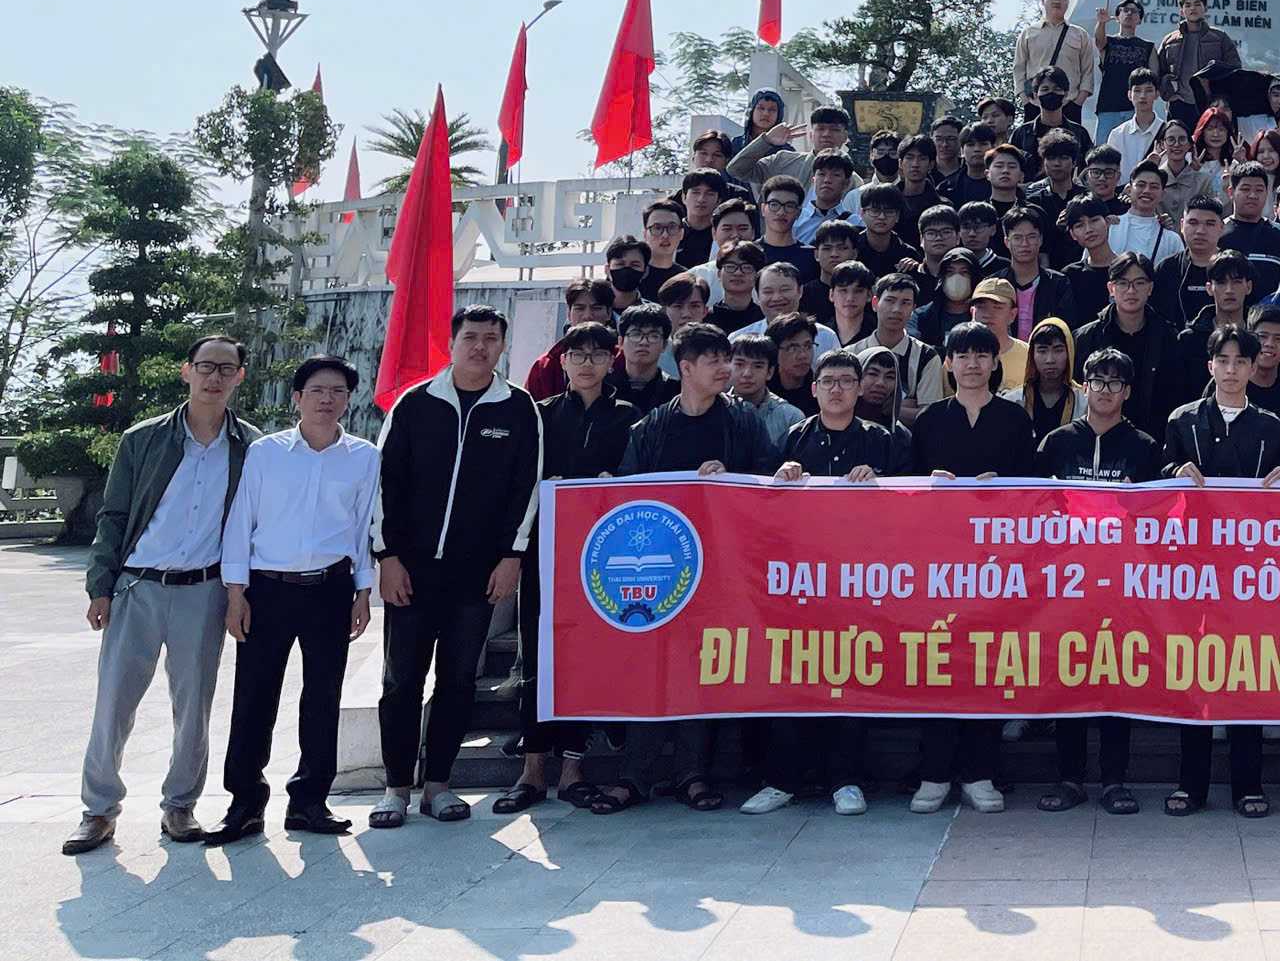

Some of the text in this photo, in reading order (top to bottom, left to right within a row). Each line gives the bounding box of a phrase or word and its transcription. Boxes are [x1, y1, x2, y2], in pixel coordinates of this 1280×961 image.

[1214, 11, 1241, 26] LÀM
[1244, 15, 1272, 29] NÊN
[1078, 467, 1093, 476] THE
[969, 515, 1122, 545] TRƯỜNG
[1135, 518, 1197, 551] ĐẠI
[620, 585, 657, 600] TBU
[767, 561, 826, 604] ĐẠI
[841, 563, 914, 606] HỌC
[928, 557, 1027, 599] KHÓA
[1042, 564, 1085, 598] 12
[1124, 563, 1220, 601] KHOA
[700, 627, 749, 685] ĐI
[766, 625, 884, 698] THỰC
[900, 614, 956, 686] TẾ
[969, 632, 1040, 699] TẠI
[1058, 618, 1150, 688] CÁC
